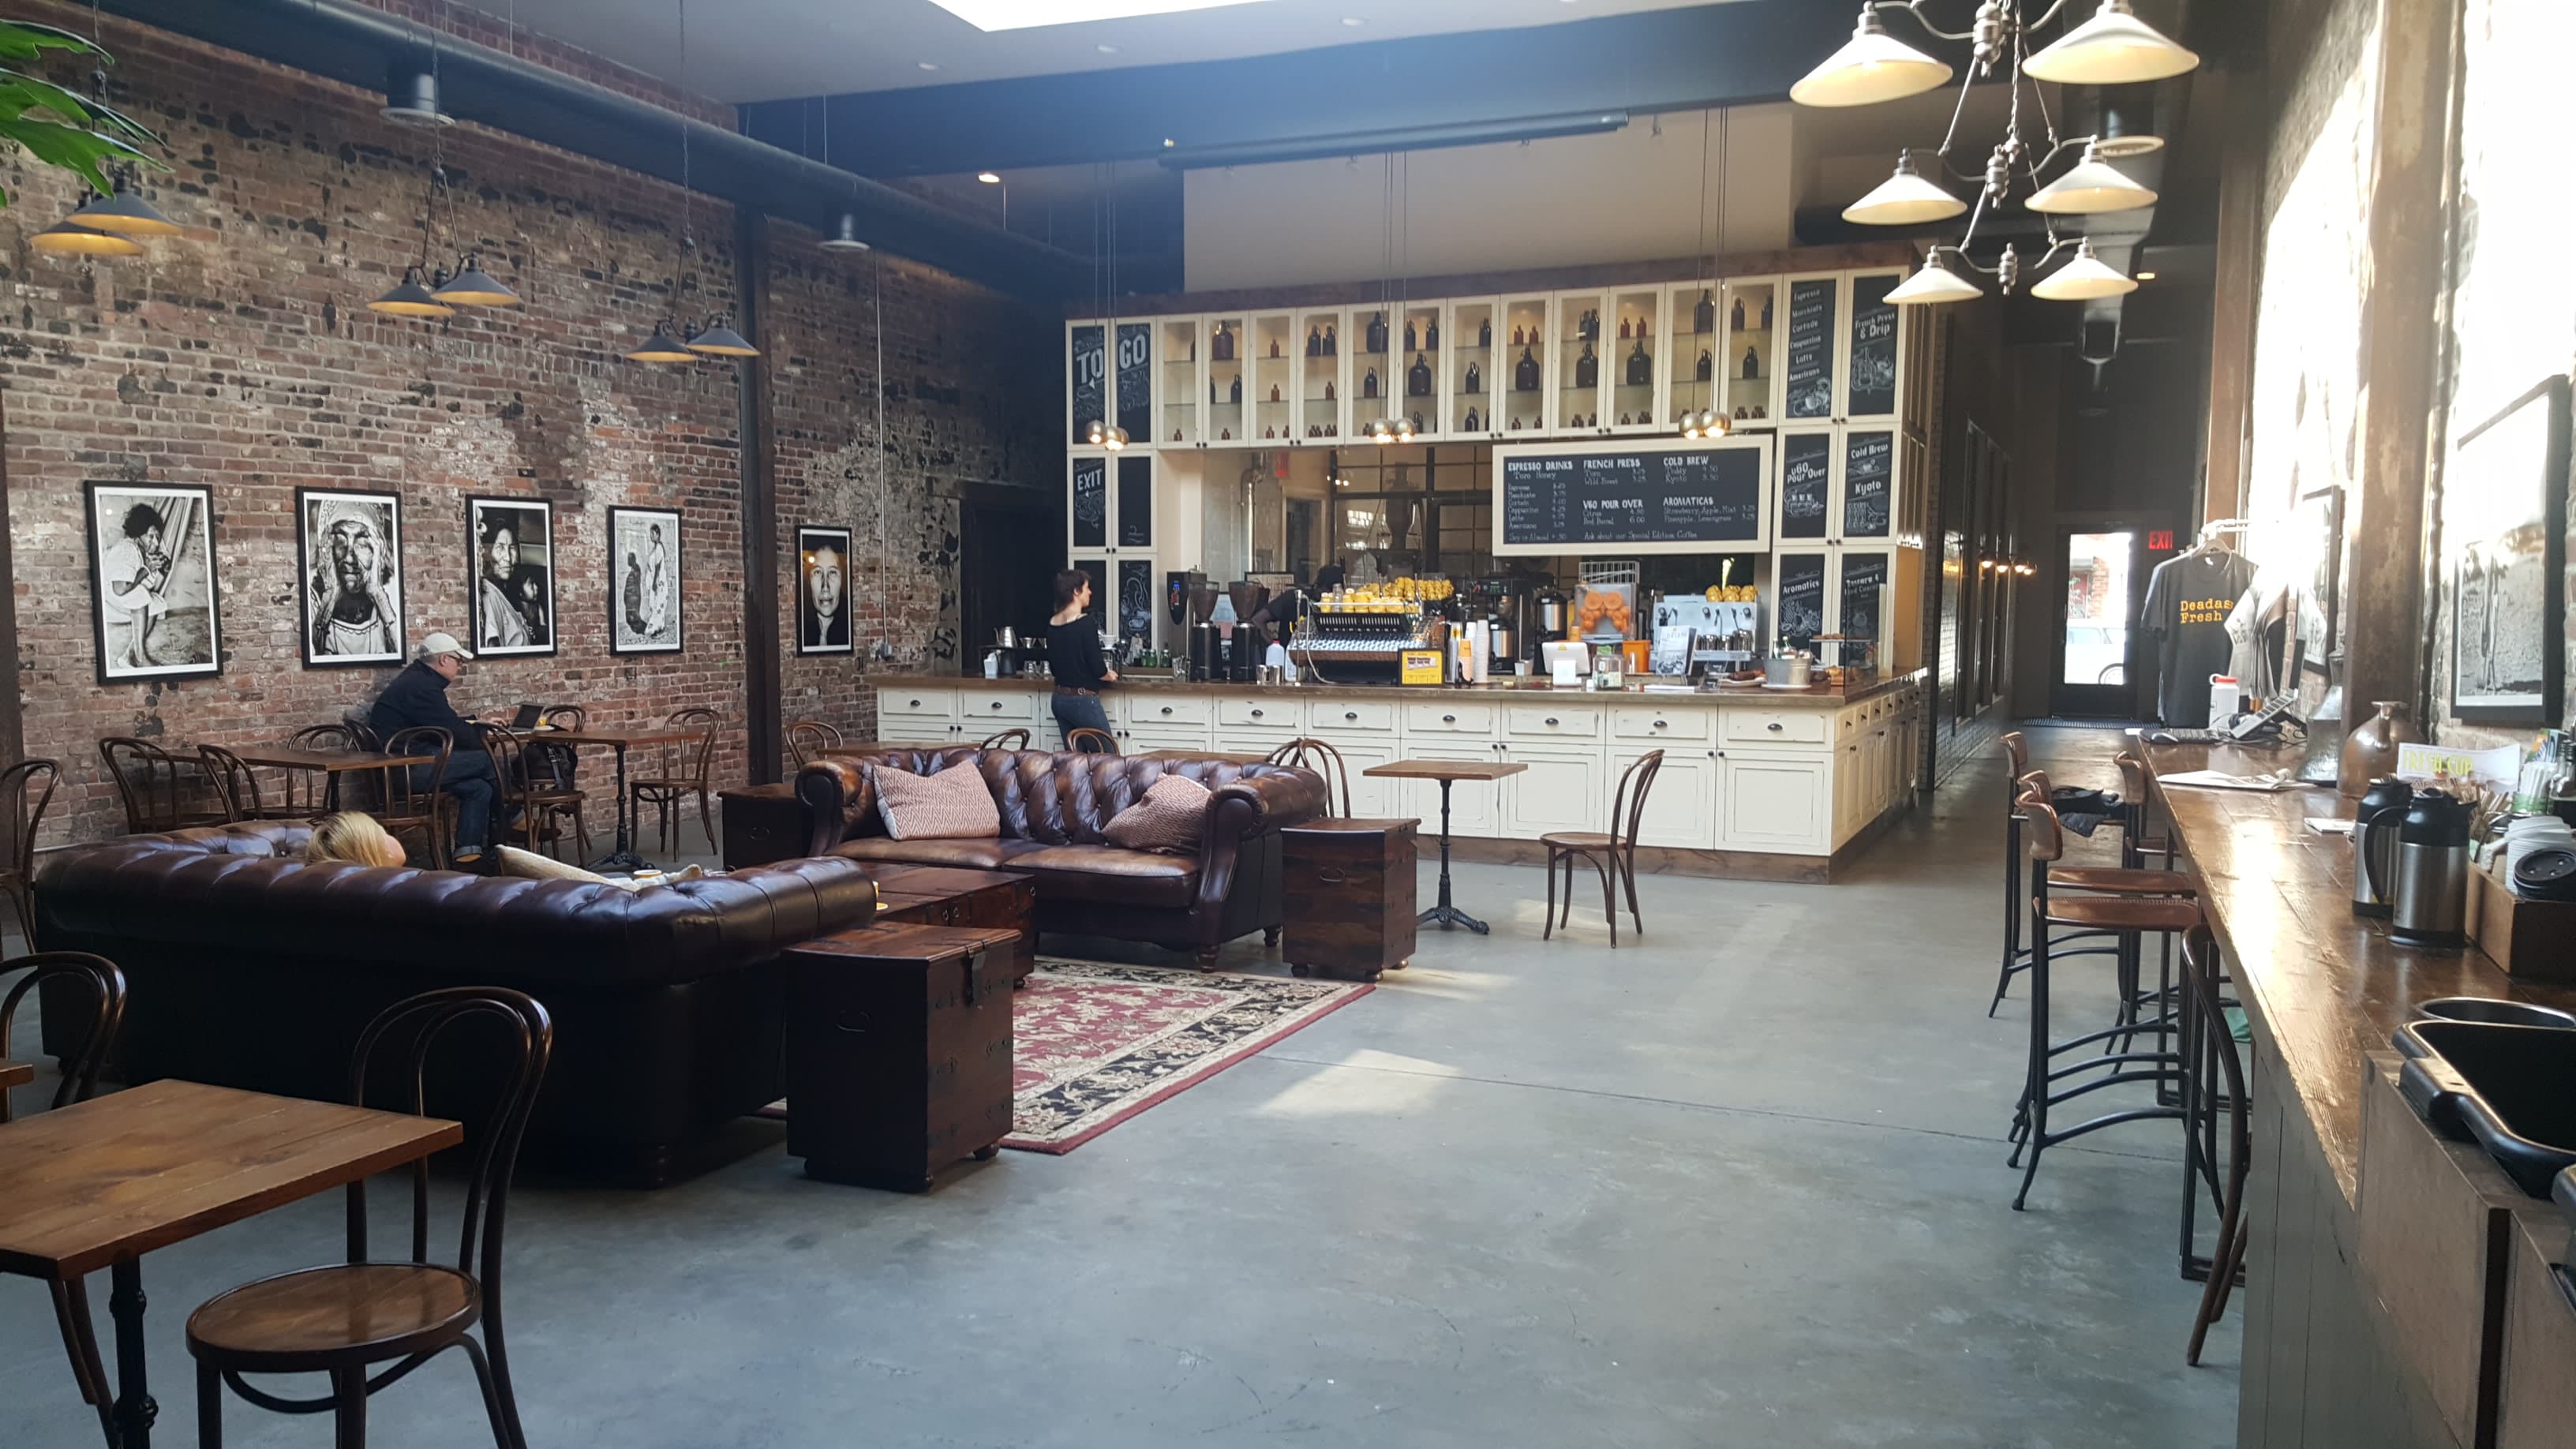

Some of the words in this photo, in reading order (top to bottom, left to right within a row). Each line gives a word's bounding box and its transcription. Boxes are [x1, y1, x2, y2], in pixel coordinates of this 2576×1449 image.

[1870, 322, 1890, 337] Drip
[1076, 348, 1104, 384] TO
[1119, 334, 1146, 369] GO
[1851, 446, 1867, 459] Cold
[1869, 444, 1888, 455] Brew
[1507, 462, 1541, 472] ESPRESSO
[1545, 460, 1573, 470] DRINKS
[1583, 459, 1614, 469] FRENCH
[1617, 458, 1641, 468] PRESS
[1663, 457, 1683, 466] COLD
[1687, 455, 1709, 466] BREW
[1077, 470, 1103, 491] EXIT
[1807, 467, 1826, 479] Over
[1855, 480, 1881, 496] Kyoto
[1601, 498, 1619, 509] POUR
[1622, 497, 1643, 508] OVER
[1782, 579, 1819, 594] Aromatics
[2180, 610, 2222, 624] Fresh
[2402, 749, 2443, 774] FRESH
[2447, 756, 2475, 777] CUP
